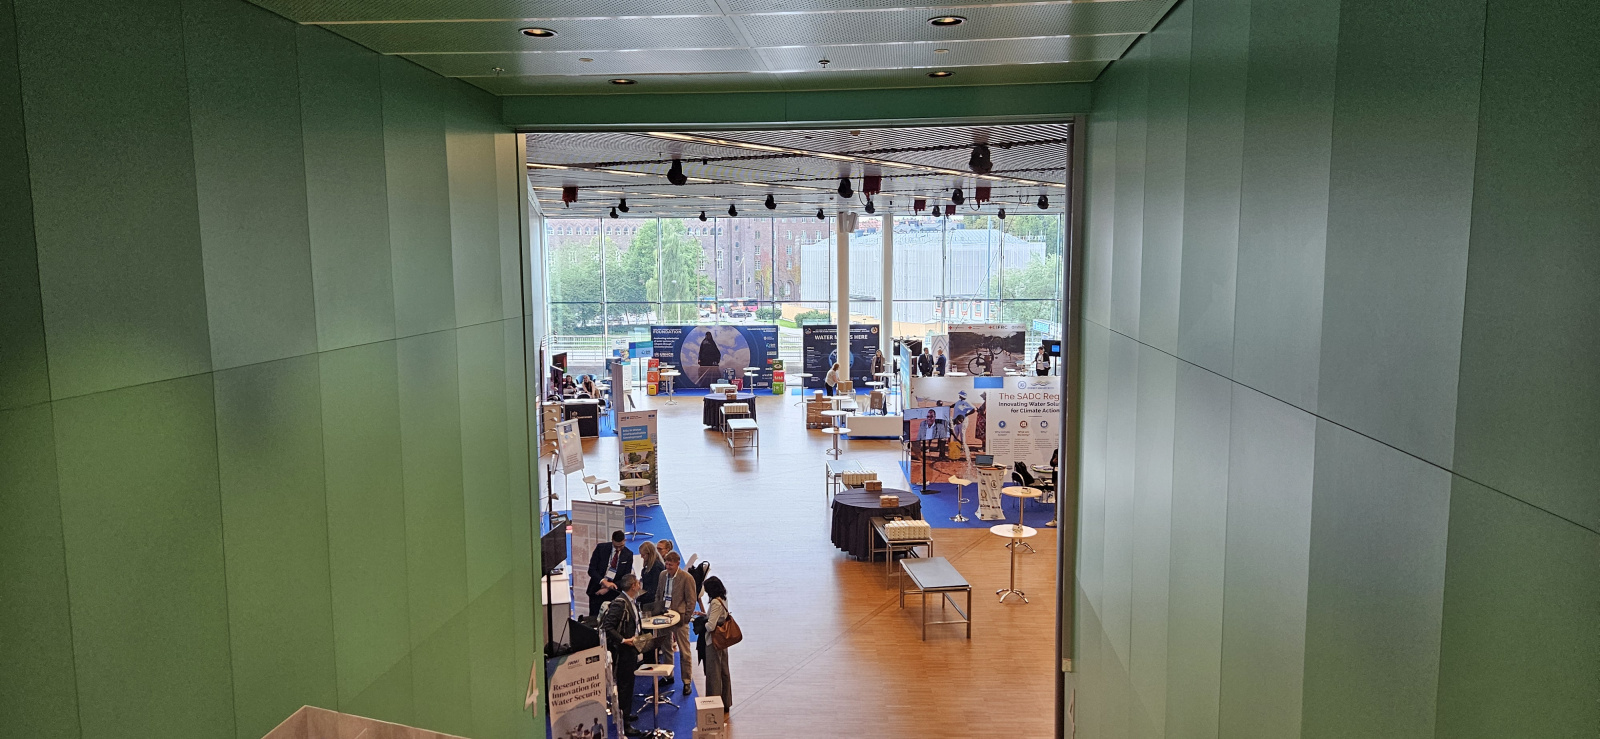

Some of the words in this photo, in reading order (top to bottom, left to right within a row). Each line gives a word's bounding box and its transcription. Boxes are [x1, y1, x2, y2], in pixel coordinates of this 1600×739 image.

[999, 392, 1015, 400] The
[1017, 392, 1040, 400] SADC
[523, 659, 539, 719] 4
[552, 684, 589, 699] Innovation
[590, 681, 601, 689] for
[553, 677, 585, 692] Research
[586, 673, 600, 682] and
[551, 697, 573, 707] Water
[574, 689, 603, 701] Security
